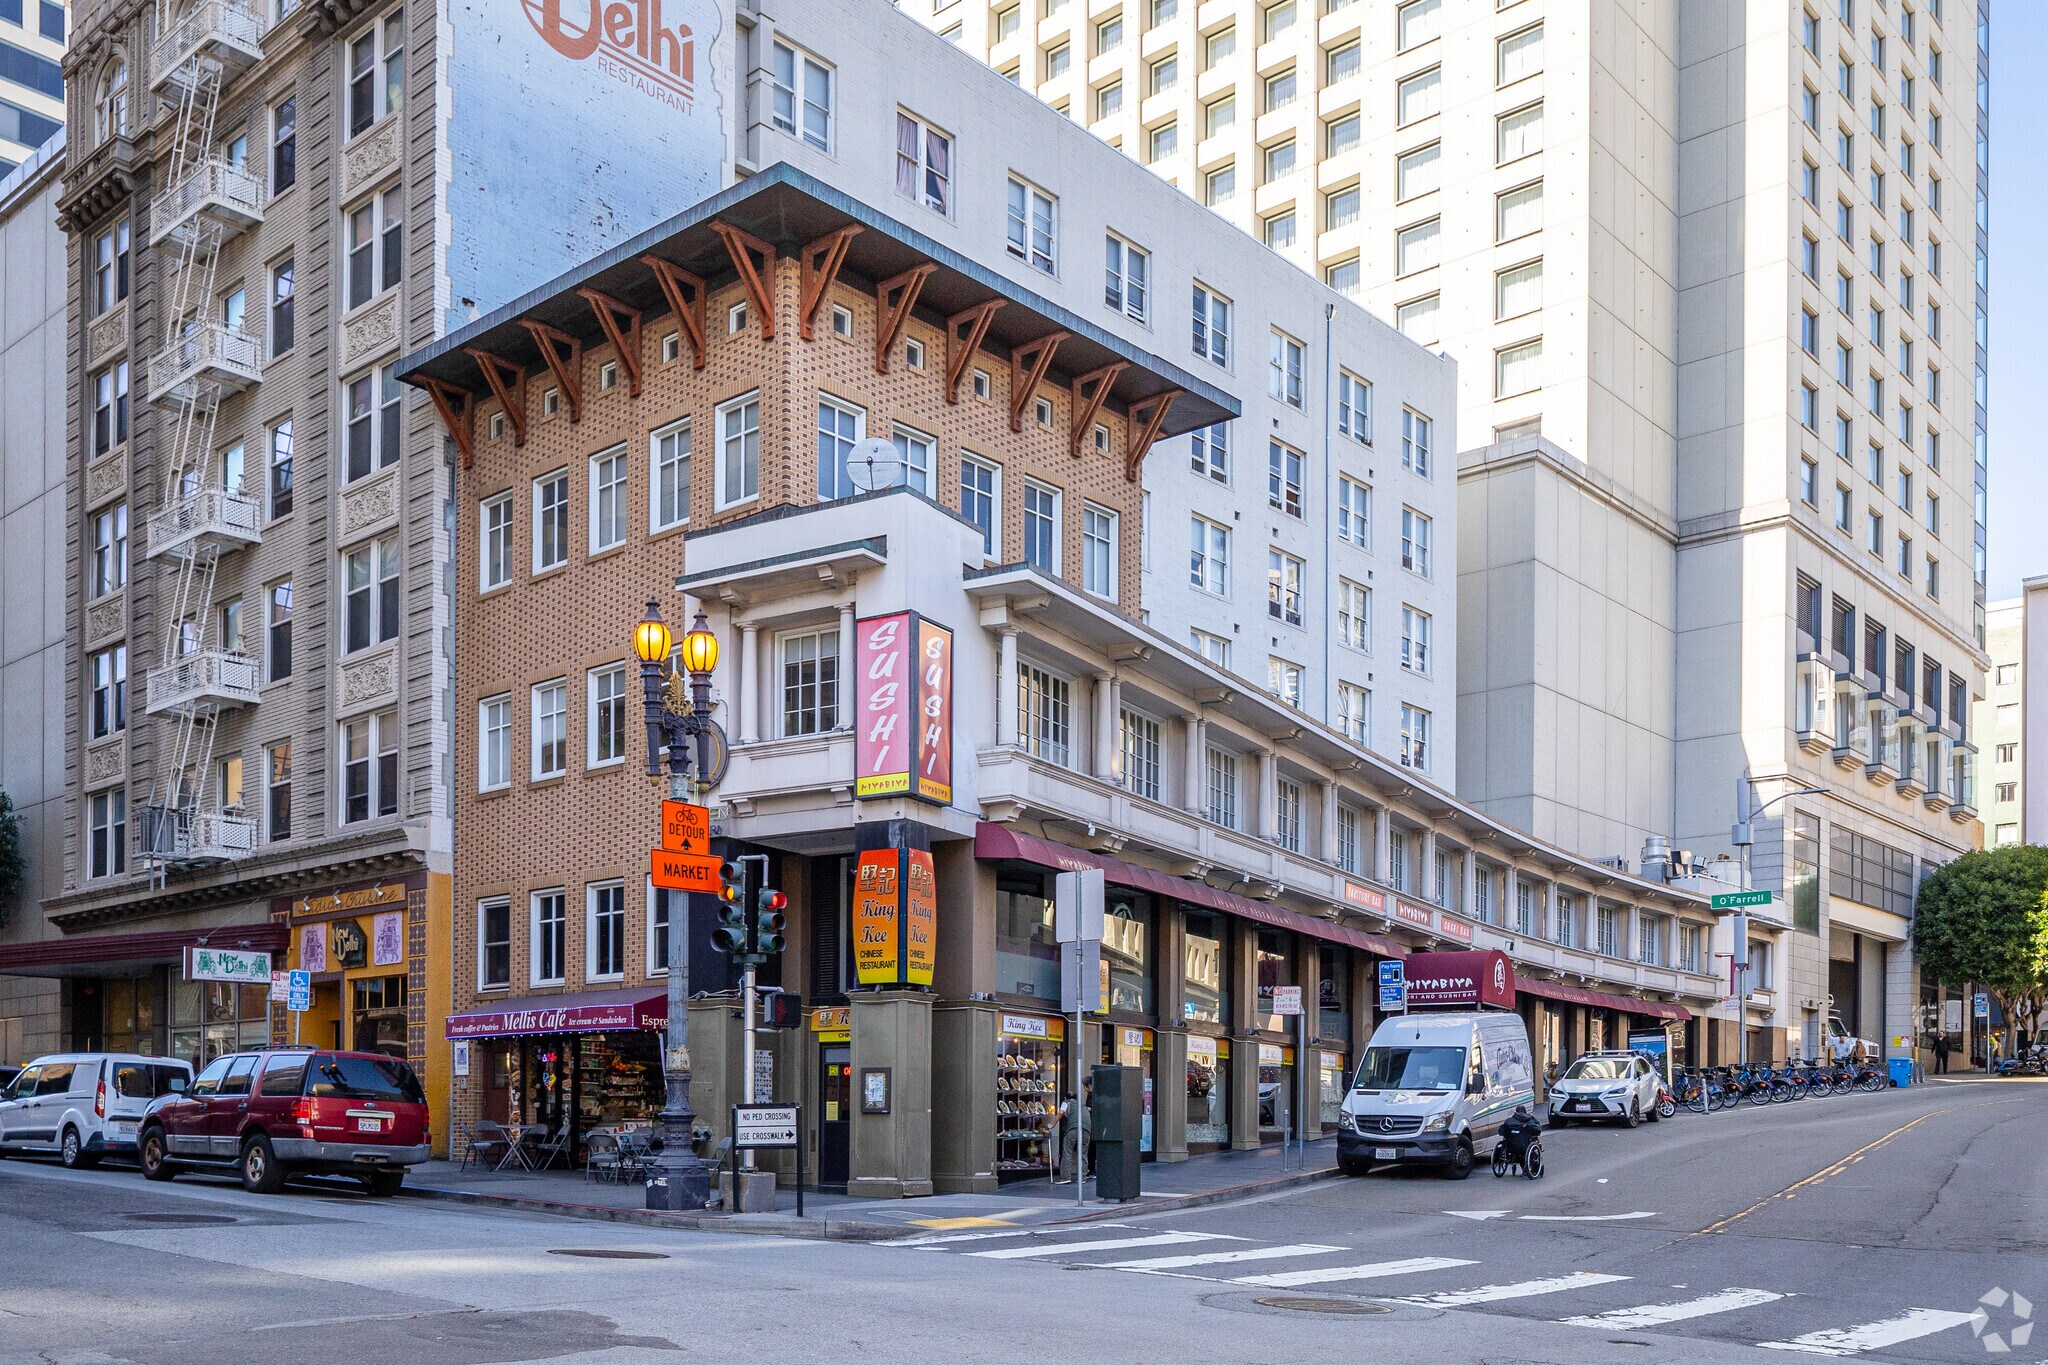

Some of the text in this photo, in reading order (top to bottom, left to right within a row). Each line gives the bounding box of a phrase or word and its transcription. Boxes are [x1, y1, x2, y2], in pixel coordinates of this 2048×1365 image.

[598, 56, 694, 117] RESTAURANT
[868, 620, 900, 773] SUSHI
[924, 636, 945, 776] SUSHI
[861, 778, 908, 792] MIYABIYA
[669, 822, 705, 840] DETOUR
[664, 862, 710, 881] MARKET
[1371, 894, 1382, 907] BAR
[1719, 893, 1764, 905] O'Farrell
[860, 899, 896, 922] King
[909, 898, 933, 925] King
[1399, 904, 1429, 924] MIYABIYA
[860, 925, 888, 945] Kee
[909, 923, 928, 945] Kee
[1443, 920, 1470, 938] SUSHI BAR
[333, 934, 359, 961] Delhi
[860, 949, 884, 959] CHINESE
[909, 949, 925, 960] CHINESE
[218, 952, 239, 966] New
[860, 960, 896, 971] RESTAURANT
[909, 960, 933, 972] RESTAURANT
[223, 959, 249, 974] Delhi
[1404, 977, 1473, 990] MIYABIYA
[502, 1008, 566, 1031] Mellis Café
[576, 1018, 592, 1026] cream
[592, 1016, 599, 1025] &
[599, 1015, 627, 1025] Sandwiches
[1006, 1018, 1043, 1032] King Kee
[451, 1023, 499, 1033] Fresh coffee & Pastries
[742, 1112, 791, 1121] NO PED CROSSING
[752, 1132, 785, 1140] CROSSWALK
